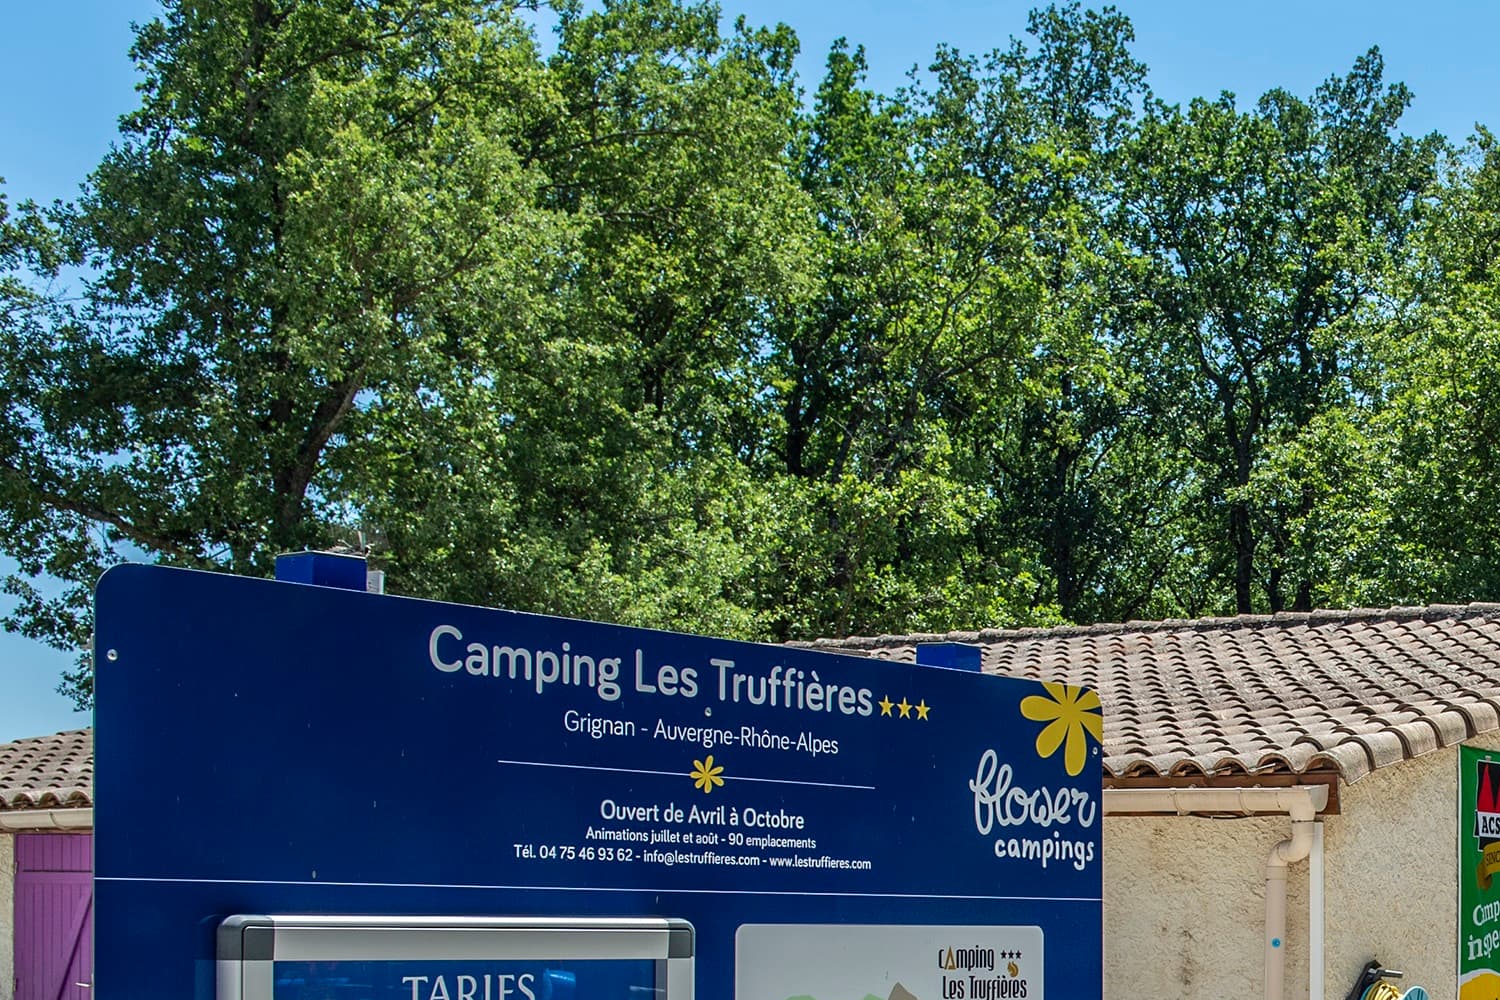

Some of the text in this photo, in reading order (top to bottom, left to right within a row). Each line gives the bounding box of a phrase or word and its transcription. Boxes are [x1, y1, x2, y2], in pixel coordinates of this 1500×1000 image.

[429, 624, 874, 717] Camping Les Truffières
[564, 709, 635, 739] Grignan
[653, 718, 839, 757] Auvergne-Rhône-Alpes
[969, 749, 1096, 835] flower
[600, 799, 805, 829] Ouvert de Avril à Octobre
[585, 825, 649, 842] Animations
[649, 829, 680, 845] juillet
[683, 832, 693, 844] et
[695, 832, 719, 845] août
[728, 832, 743, 846] 90
[745, 834, 817, 849] emplacements
[994, 831, 1094, 871] campings
[513, 843, 536, 859] Tél.
[539, 845, 556, 859] 04
[560, 846, 576, 860] 75
[578, 846, 595, 860] 46
[597, 847, 614, 861] 93
[616, 848, 633, 862] 62
[643, 849, 760, 866] info@lestruffieres.com
[769, 854, 872, 870] www.lestruffieres.com
[942, 975, 965, 1000] Les
